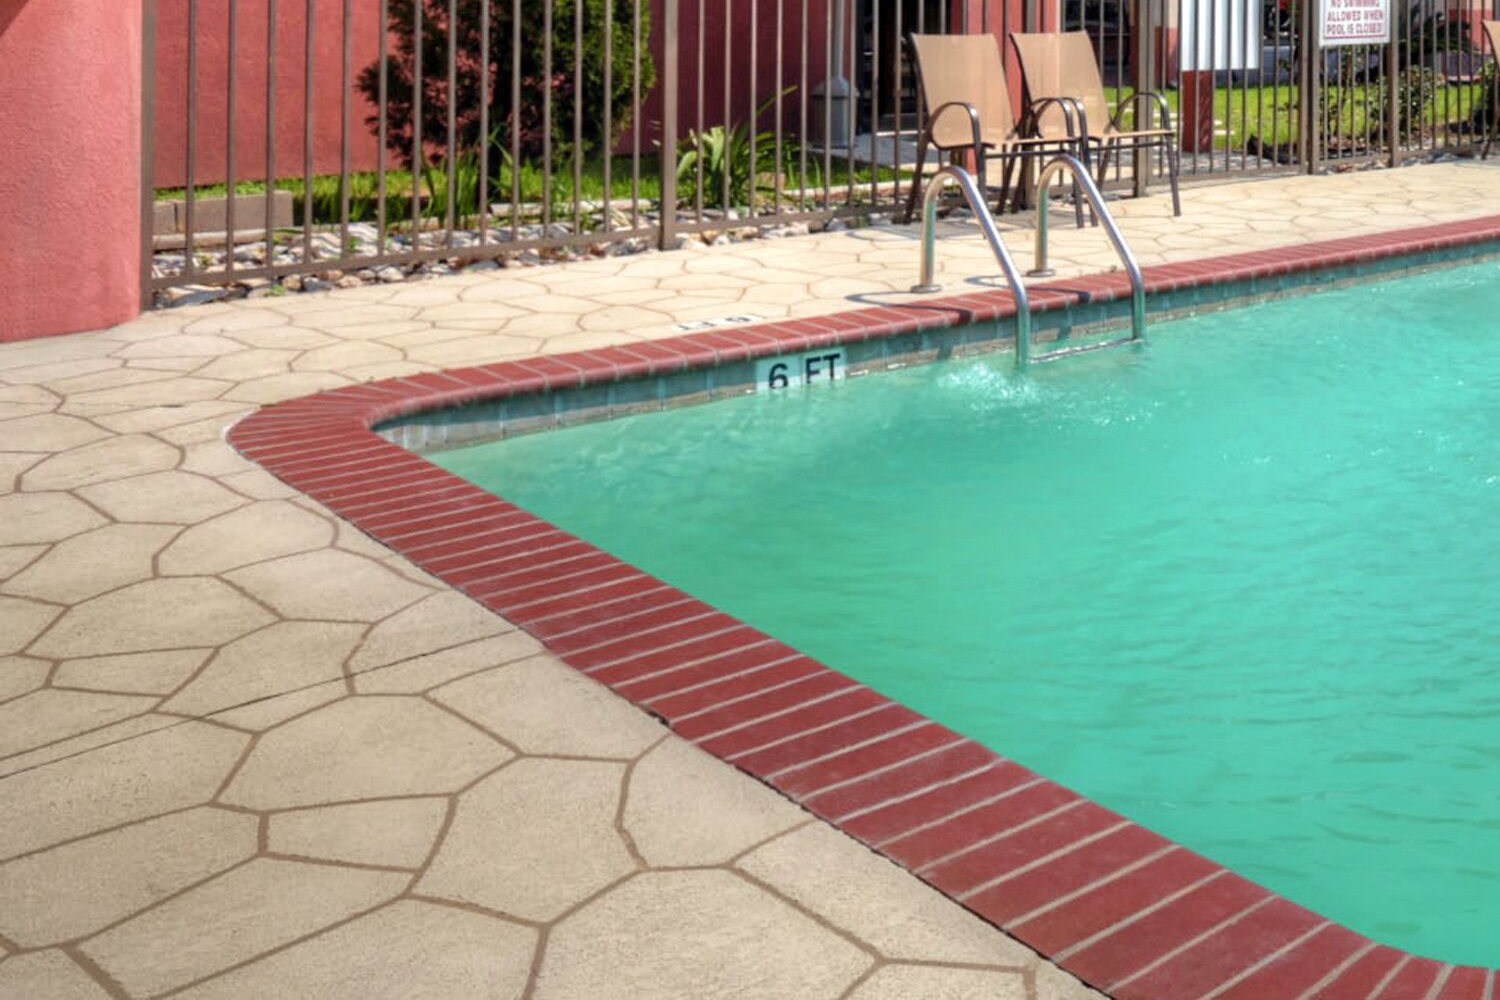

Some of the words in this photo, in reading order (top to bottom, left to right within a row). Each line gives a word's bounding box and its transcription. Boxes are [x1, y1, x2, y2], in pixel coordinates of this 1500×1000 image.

[1327, 10, 1361, 21] ALLOWED
[1364, 10, 1383, 20] WHEN
[1327, 23, 1345, 35] POOL
[1347, 23, 1354, 34] IS
[768, 362, 789, 390] 6
[805, 352, 841, 384] FT
